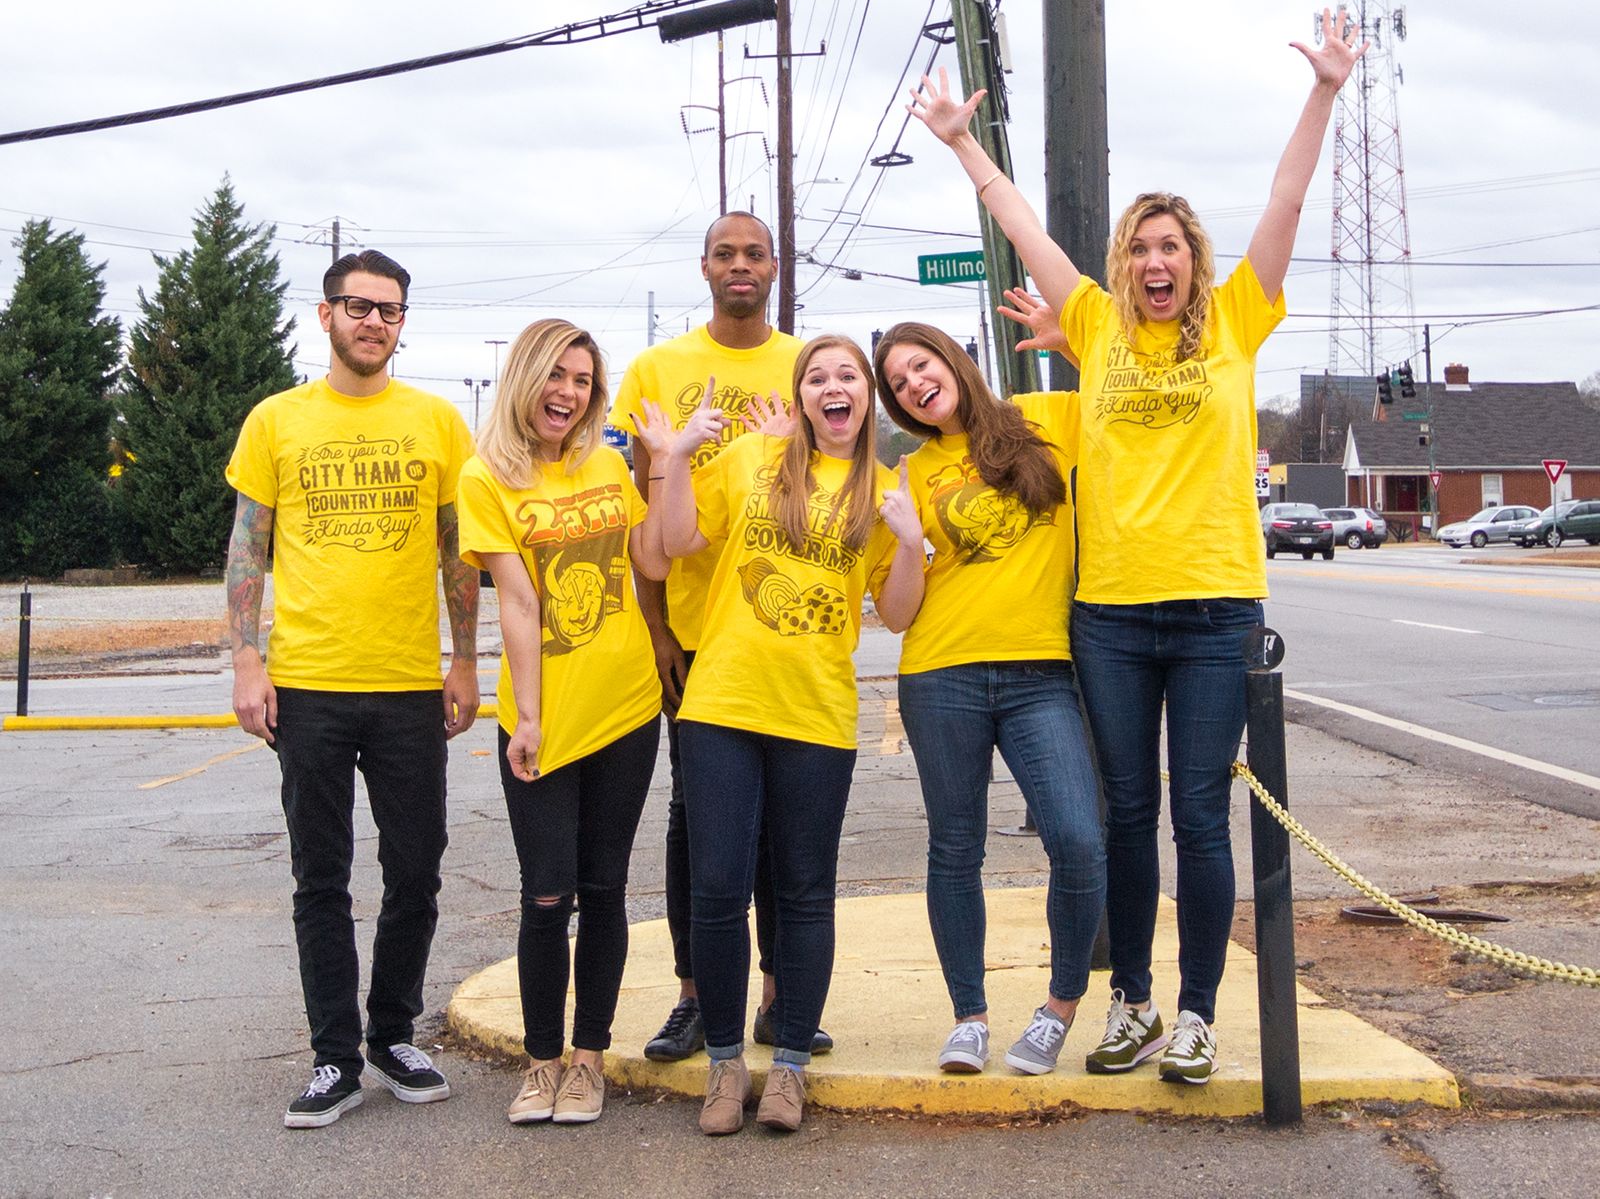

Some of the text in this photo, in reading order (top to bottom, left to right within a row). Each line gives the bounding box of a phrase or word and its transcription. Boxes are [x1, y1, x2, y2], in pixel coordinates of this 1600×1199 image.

[926, 259, 985, 279] Hillmo
[1167, 365, 1201, 388] HAM
[1104, 385, 1213, 419] Kinda Guy?
[310, 444, 399, 463] Are you a
[299, 460, 424, 490] CITY HAM OR
[311, 490, 415, 513] COUNTRY HAM
[315, 513, 421, 545] Kinda Guy?
[515, 494, 628, 549] 2am
